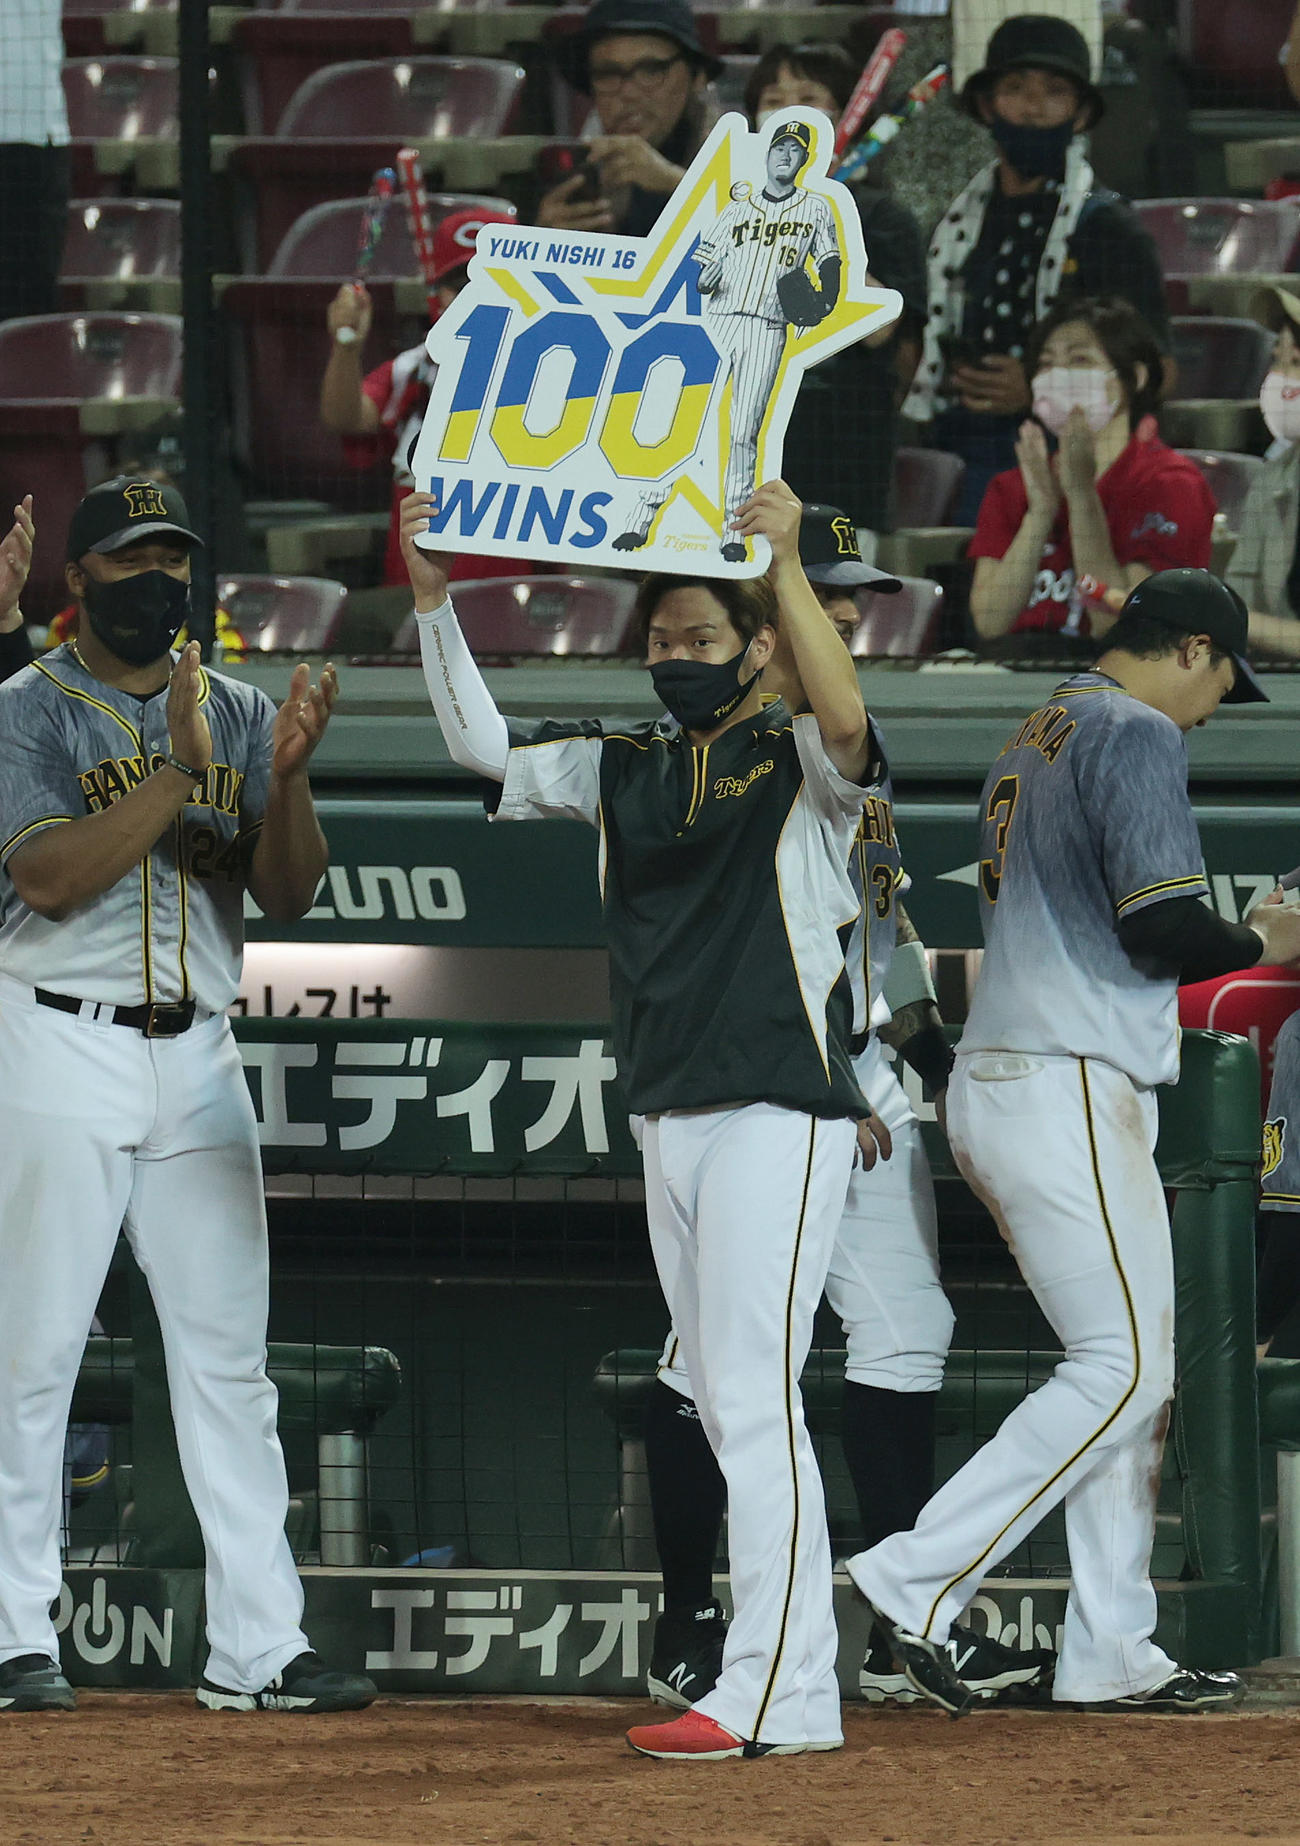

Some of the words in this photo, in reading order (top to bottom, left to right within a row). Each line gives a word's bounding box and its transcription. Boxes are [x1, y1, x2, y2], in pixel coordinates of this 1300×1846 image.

[490, 238, 539, 260] YUKI
[545, 243, 605, 267] NISHI
[611, 249, 637, 269] 16
[732, 217, 813, 248] Tigers
[778, 245, 798, 267] 16
[438, 304, 722, 482] 100
[428, 476, 613, 549] WINS
[236, 1036, 618, 1154] エディオ
[365, 1586, 664, 1678] エディオ
